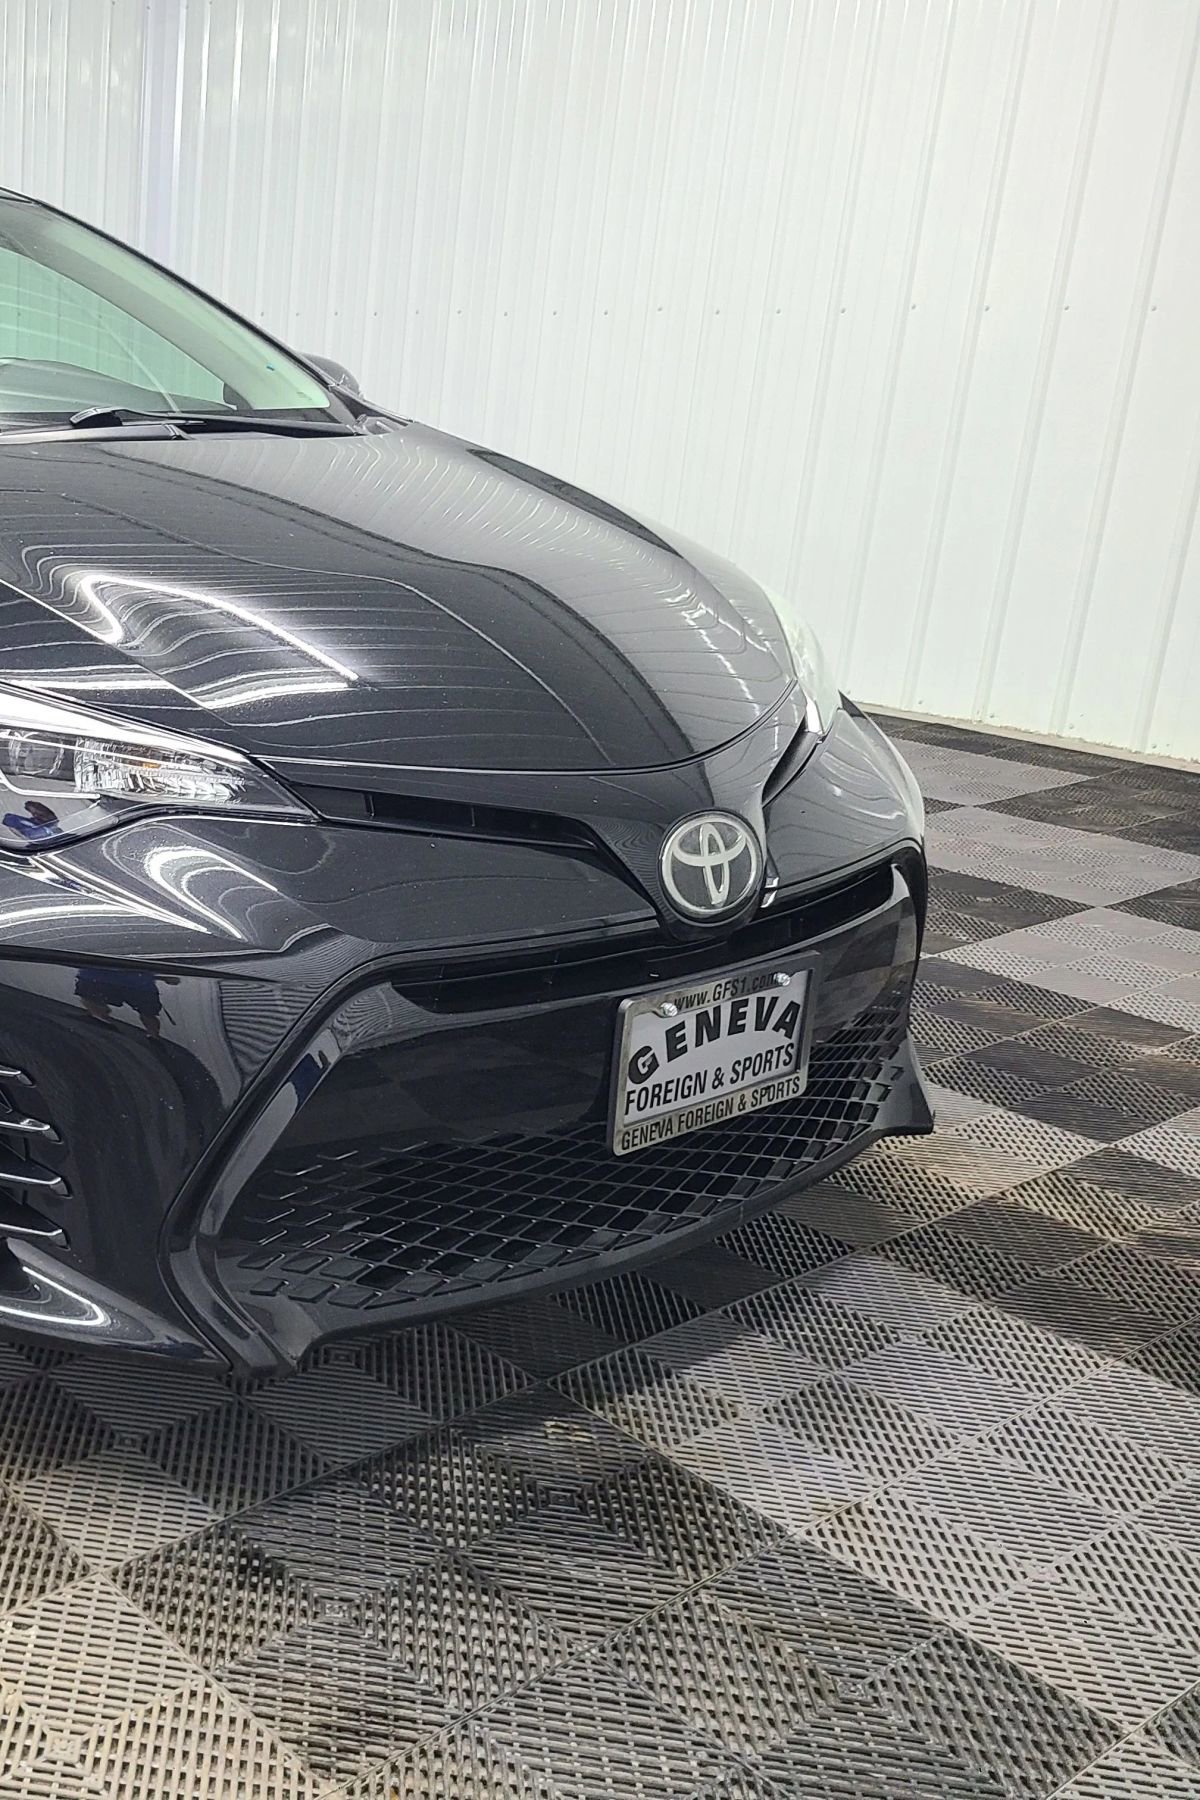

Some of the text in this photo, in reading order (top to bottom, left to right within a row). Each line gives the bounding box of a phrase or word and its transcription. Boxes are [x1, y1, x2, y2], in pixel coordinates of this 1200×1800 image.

[628, 996, 801, 1085] GENEVA
[621, 1075, 801, 1151] GENEVA FOREIGN & SPORTS
[624, 1042, 795, 1116] FOREIGN & SPORTS
